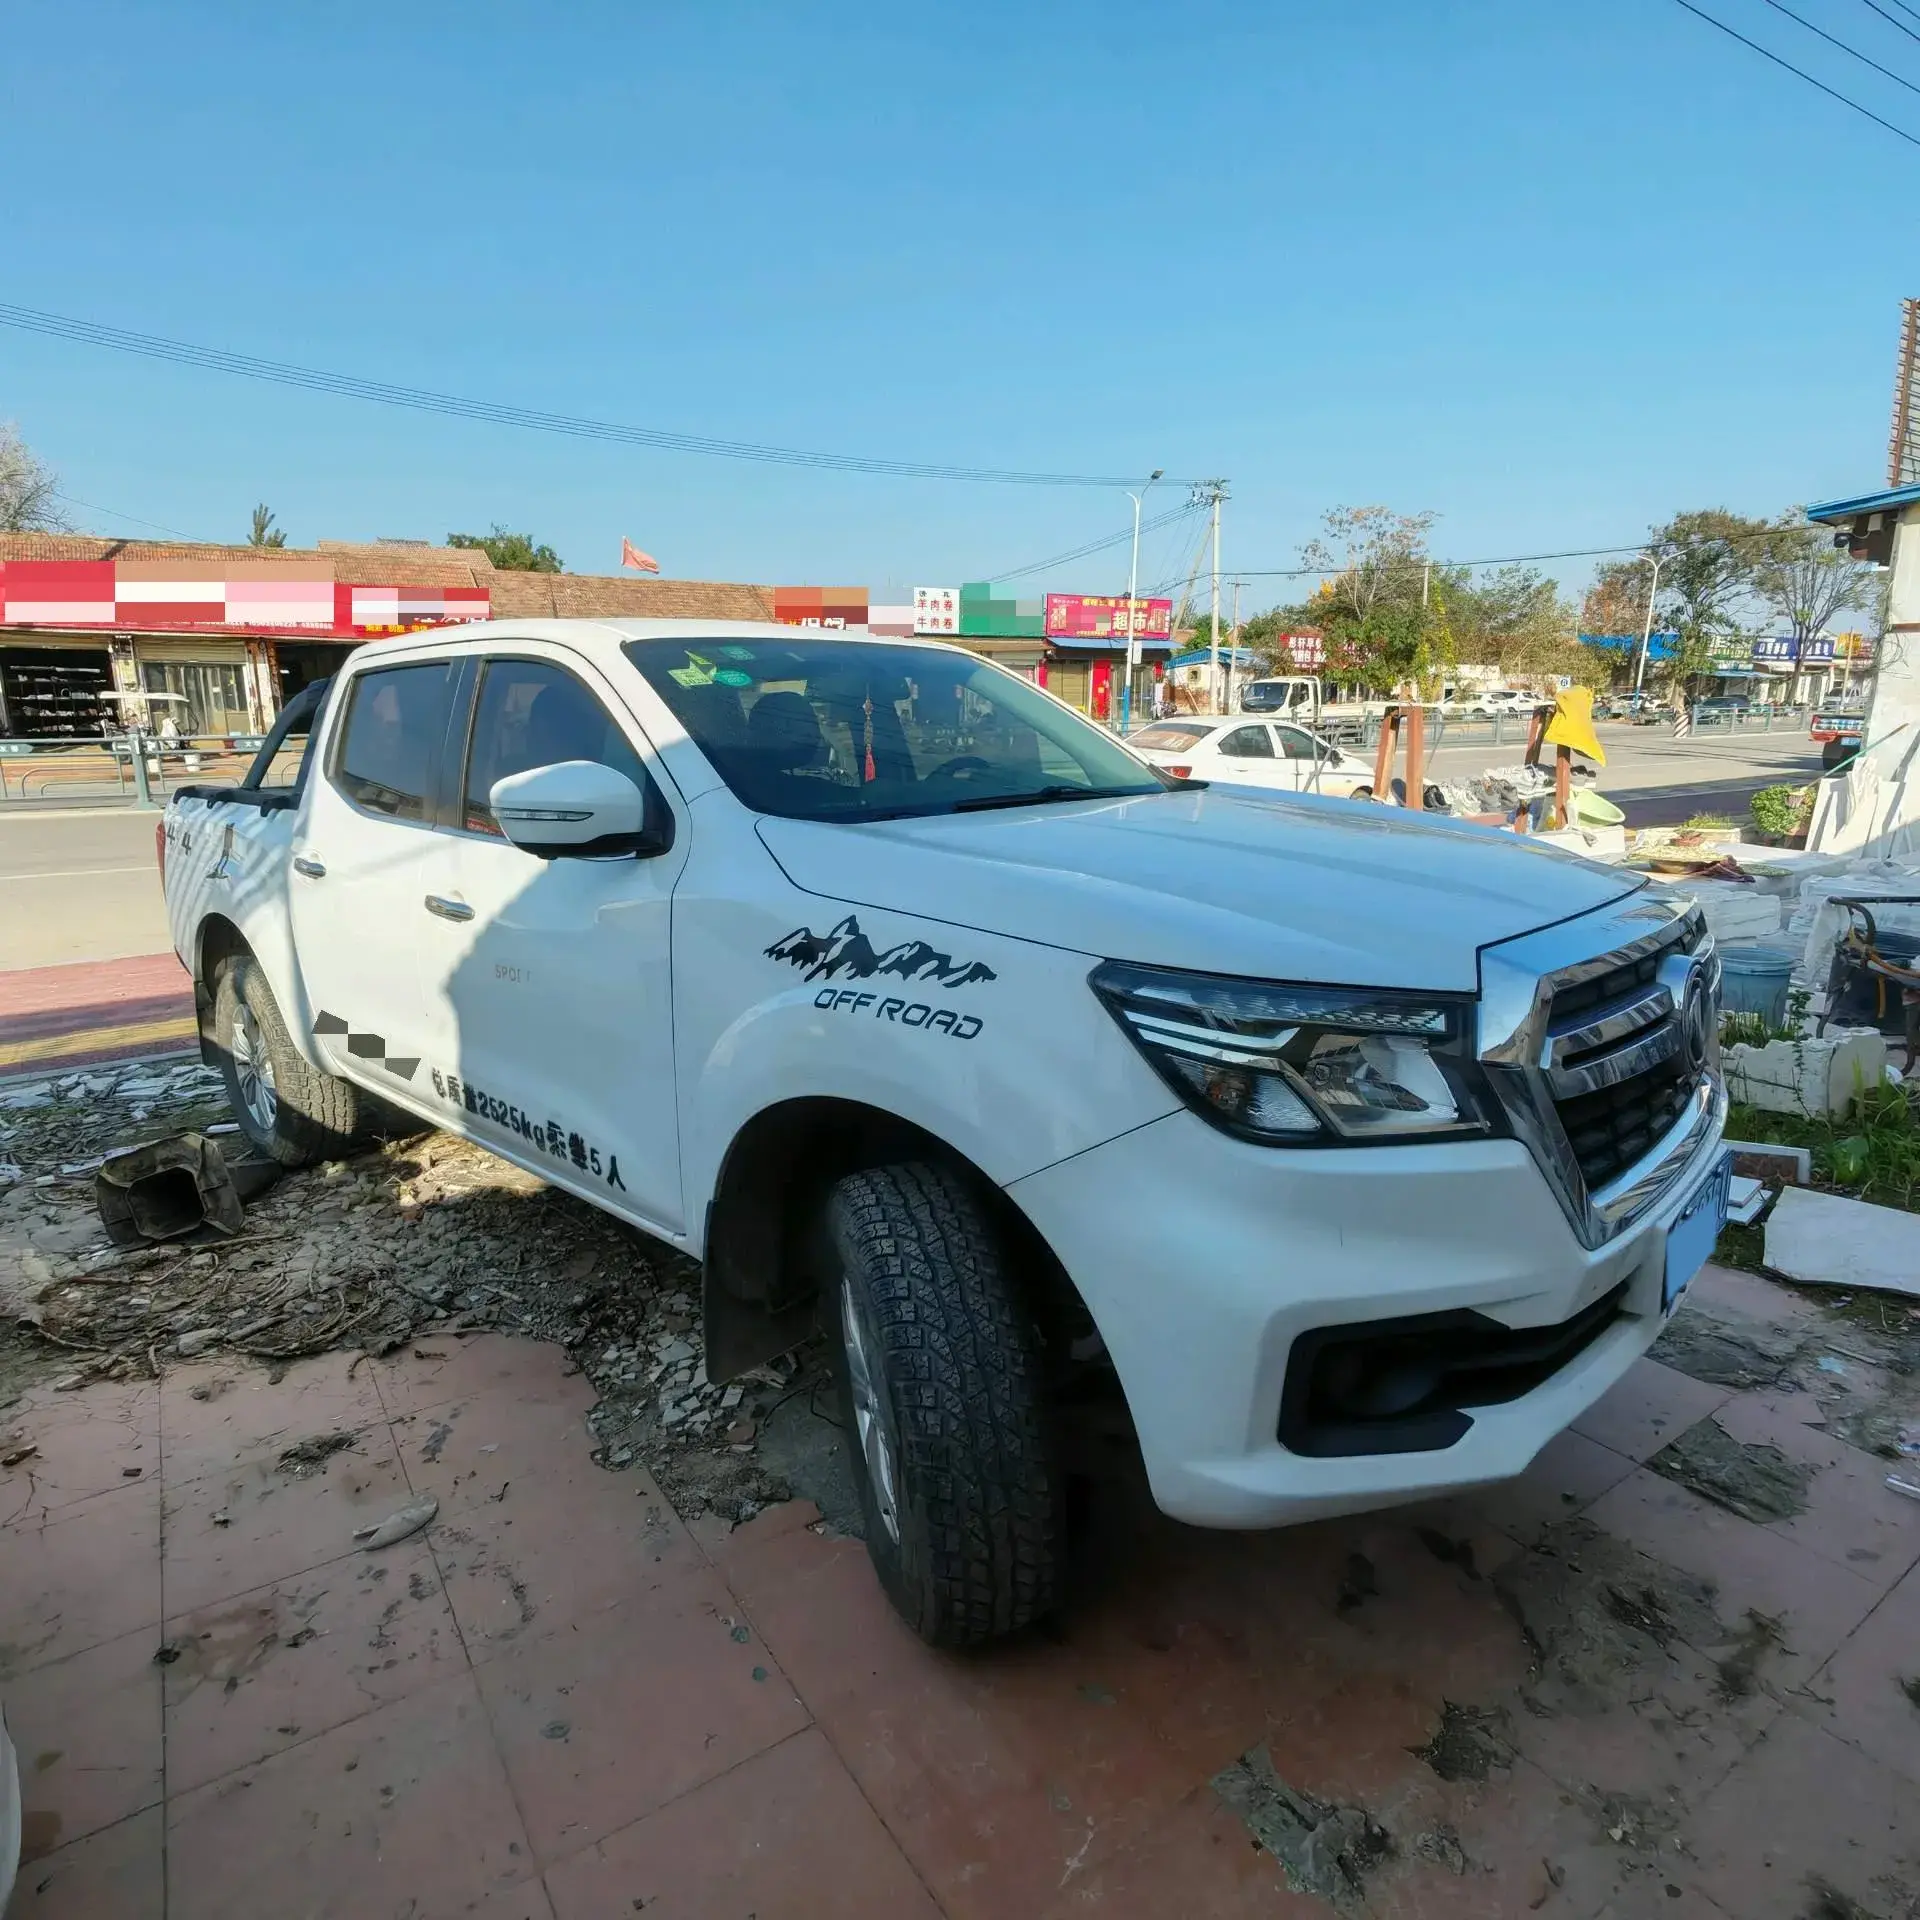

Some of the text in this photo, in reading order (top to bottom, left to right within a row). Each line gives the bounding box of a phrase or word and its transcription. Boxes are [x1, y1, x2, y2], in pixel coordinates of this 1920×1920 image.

[917, 599, 953, 611] 羊肉卷
[917, 615, 953, 629] 牛肉卷
[1112, 611, 1148, 631] 超市
[814, 988, 984, 1040] OFF ROAD
